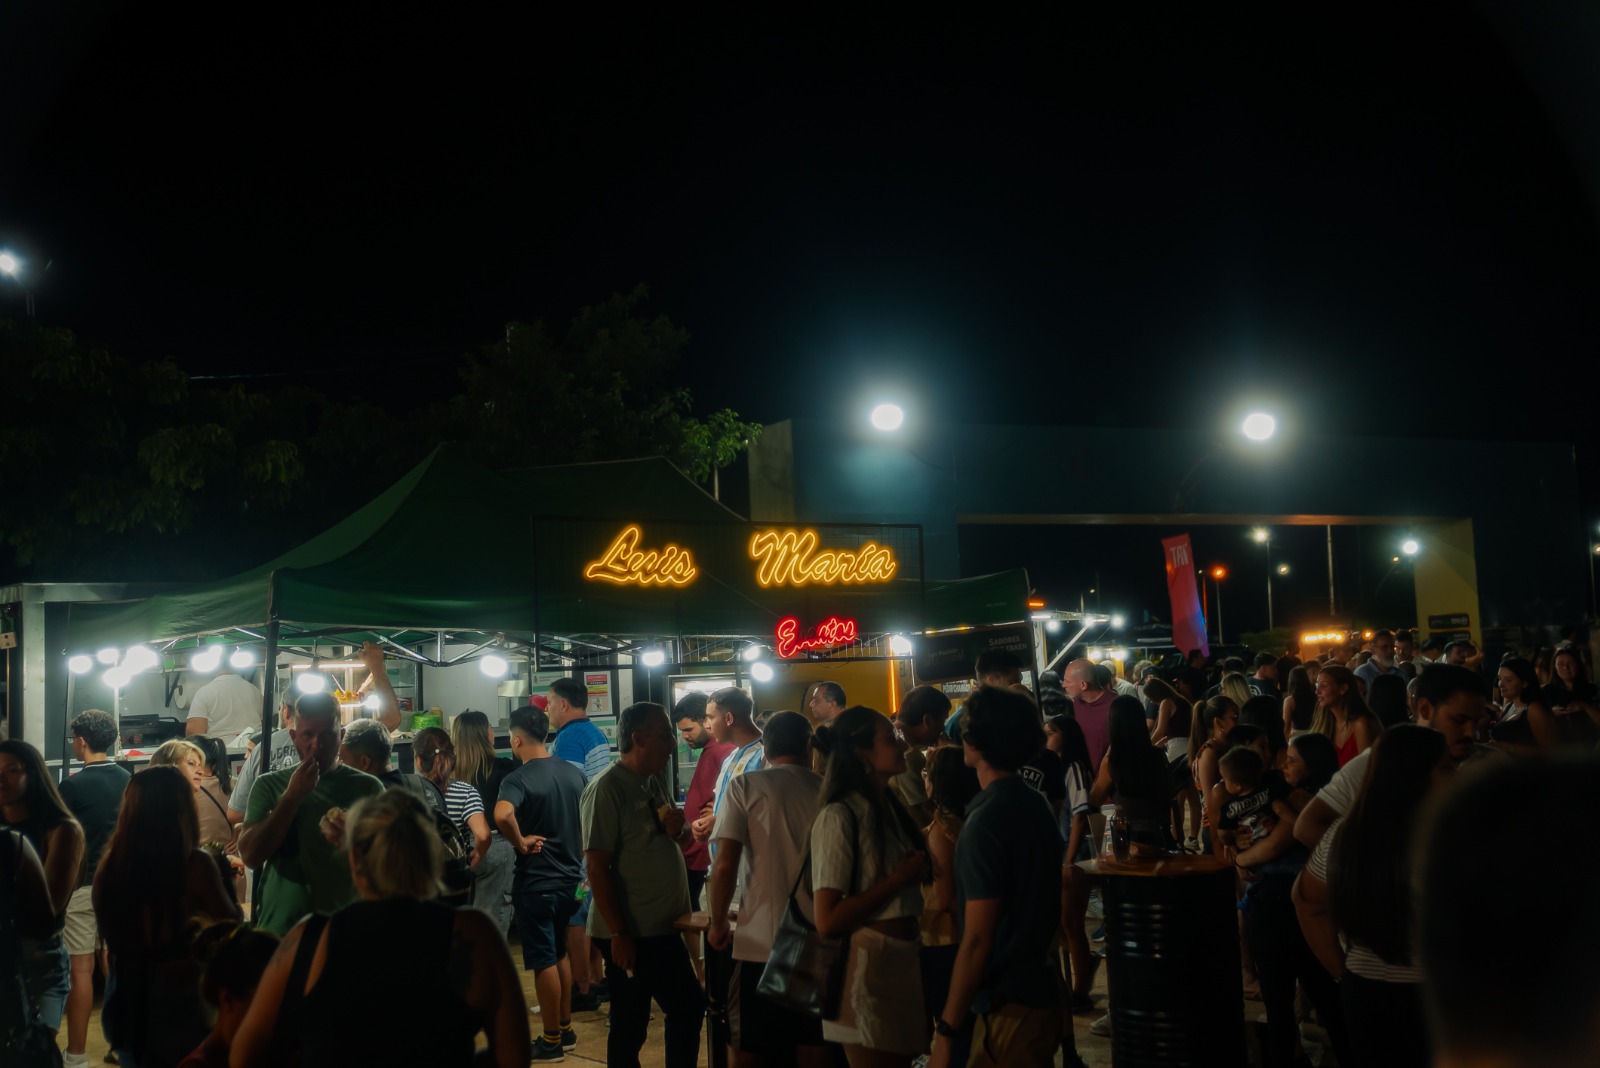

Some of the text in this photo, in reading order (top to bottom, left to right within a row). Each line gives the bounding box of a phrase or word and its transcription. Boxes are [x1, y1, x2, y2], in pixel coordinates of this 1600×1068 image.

[585, 525, 697, 586] Luis
[988, 635, 1021, 647] SABORES
[1023, 768, 1041, 783] CAT
